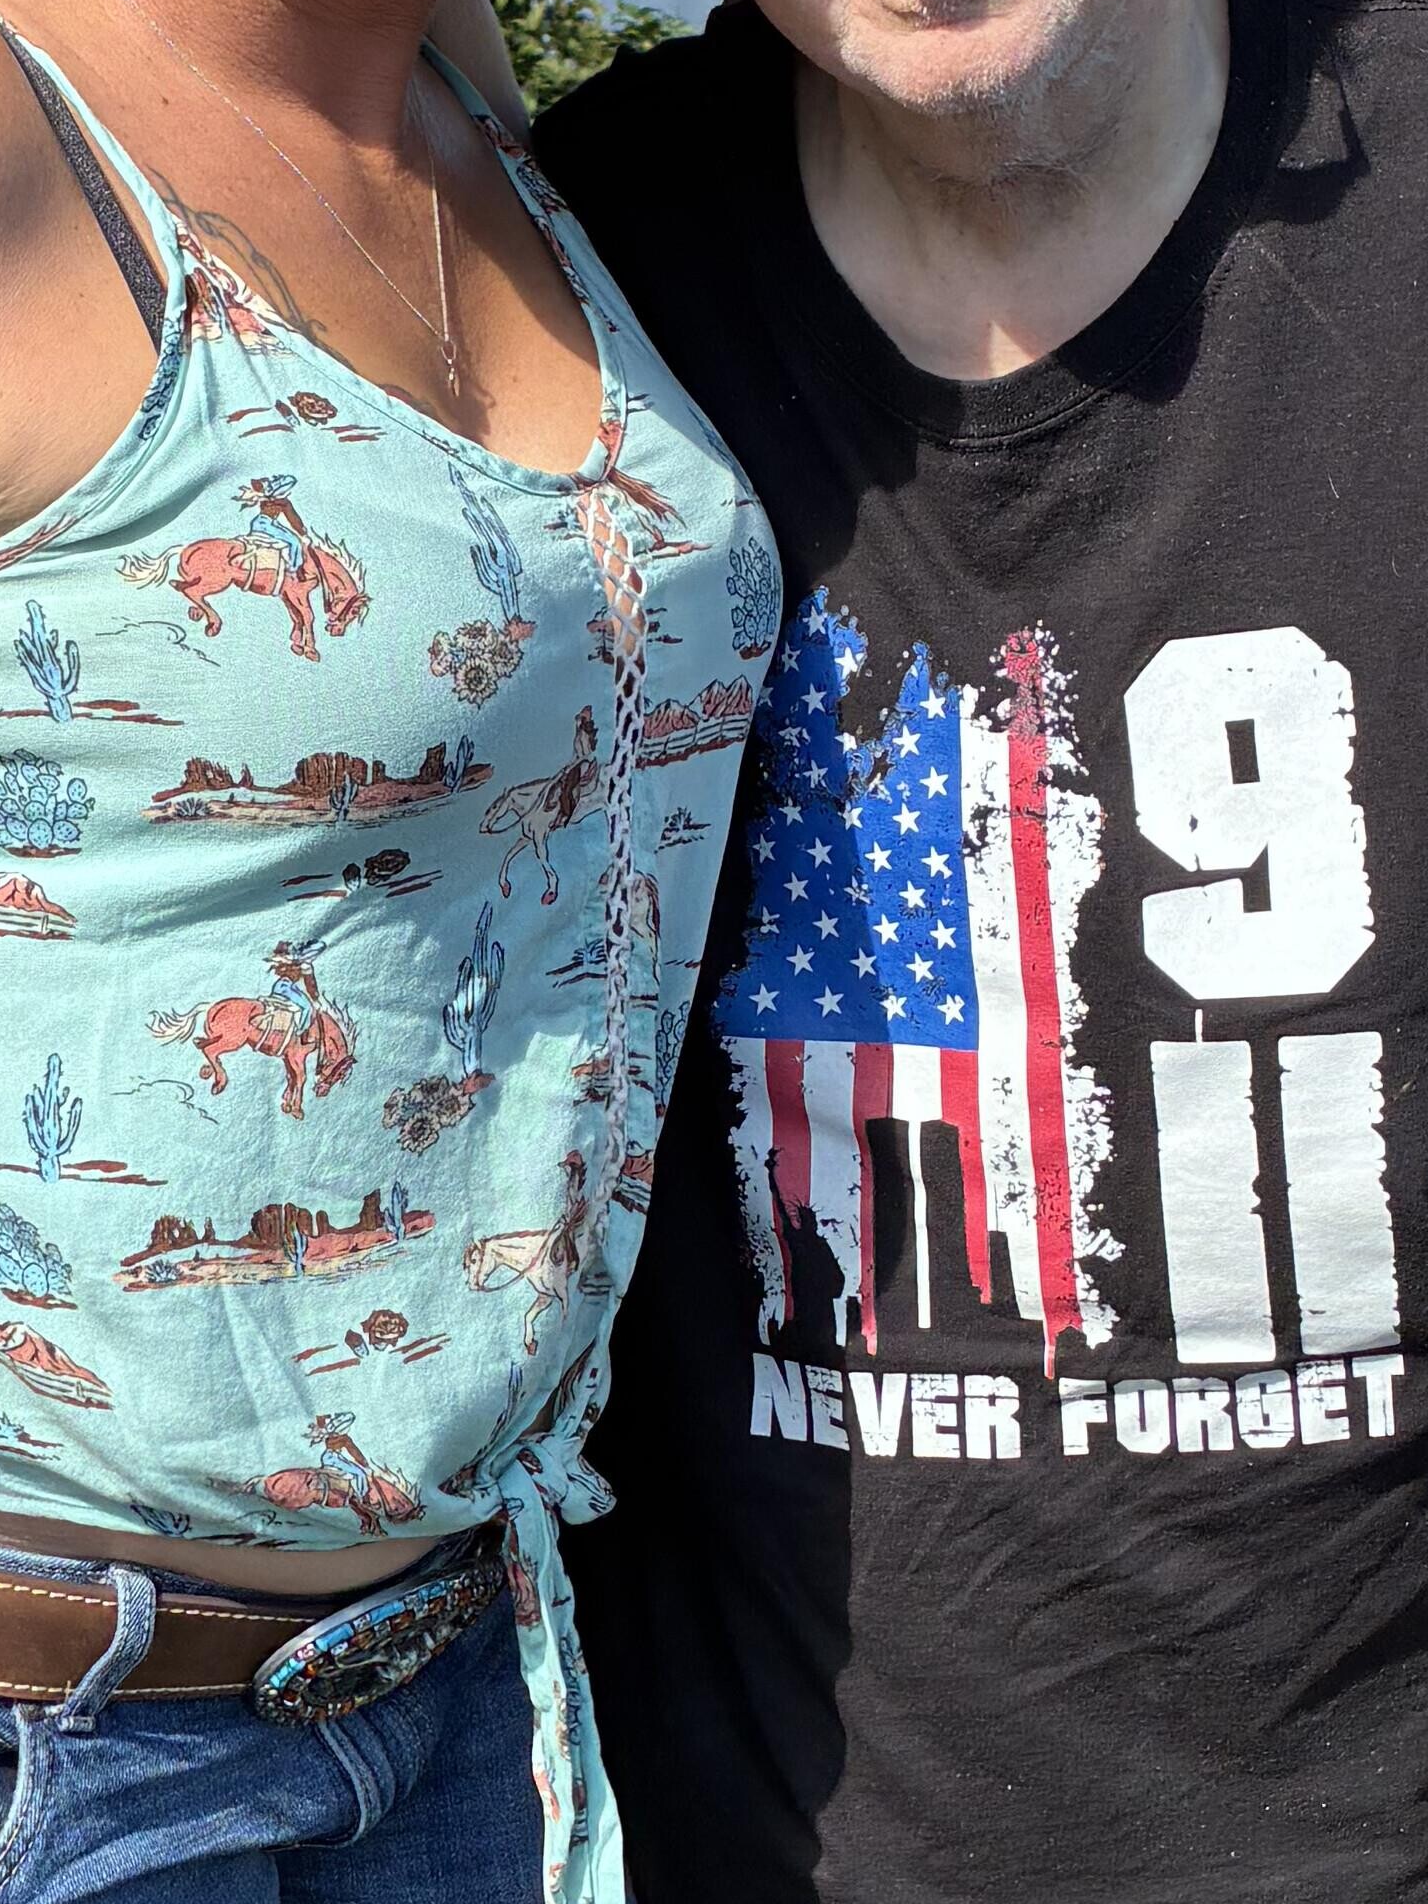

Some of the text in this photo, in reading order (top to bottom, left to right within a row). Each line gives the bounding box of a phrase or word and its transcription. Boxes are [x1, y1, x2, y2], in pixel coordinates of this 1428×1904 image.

[1123, 625, 1376, 1000] 9
[750, 1353, 1406, 1460] NEVER FORGET
